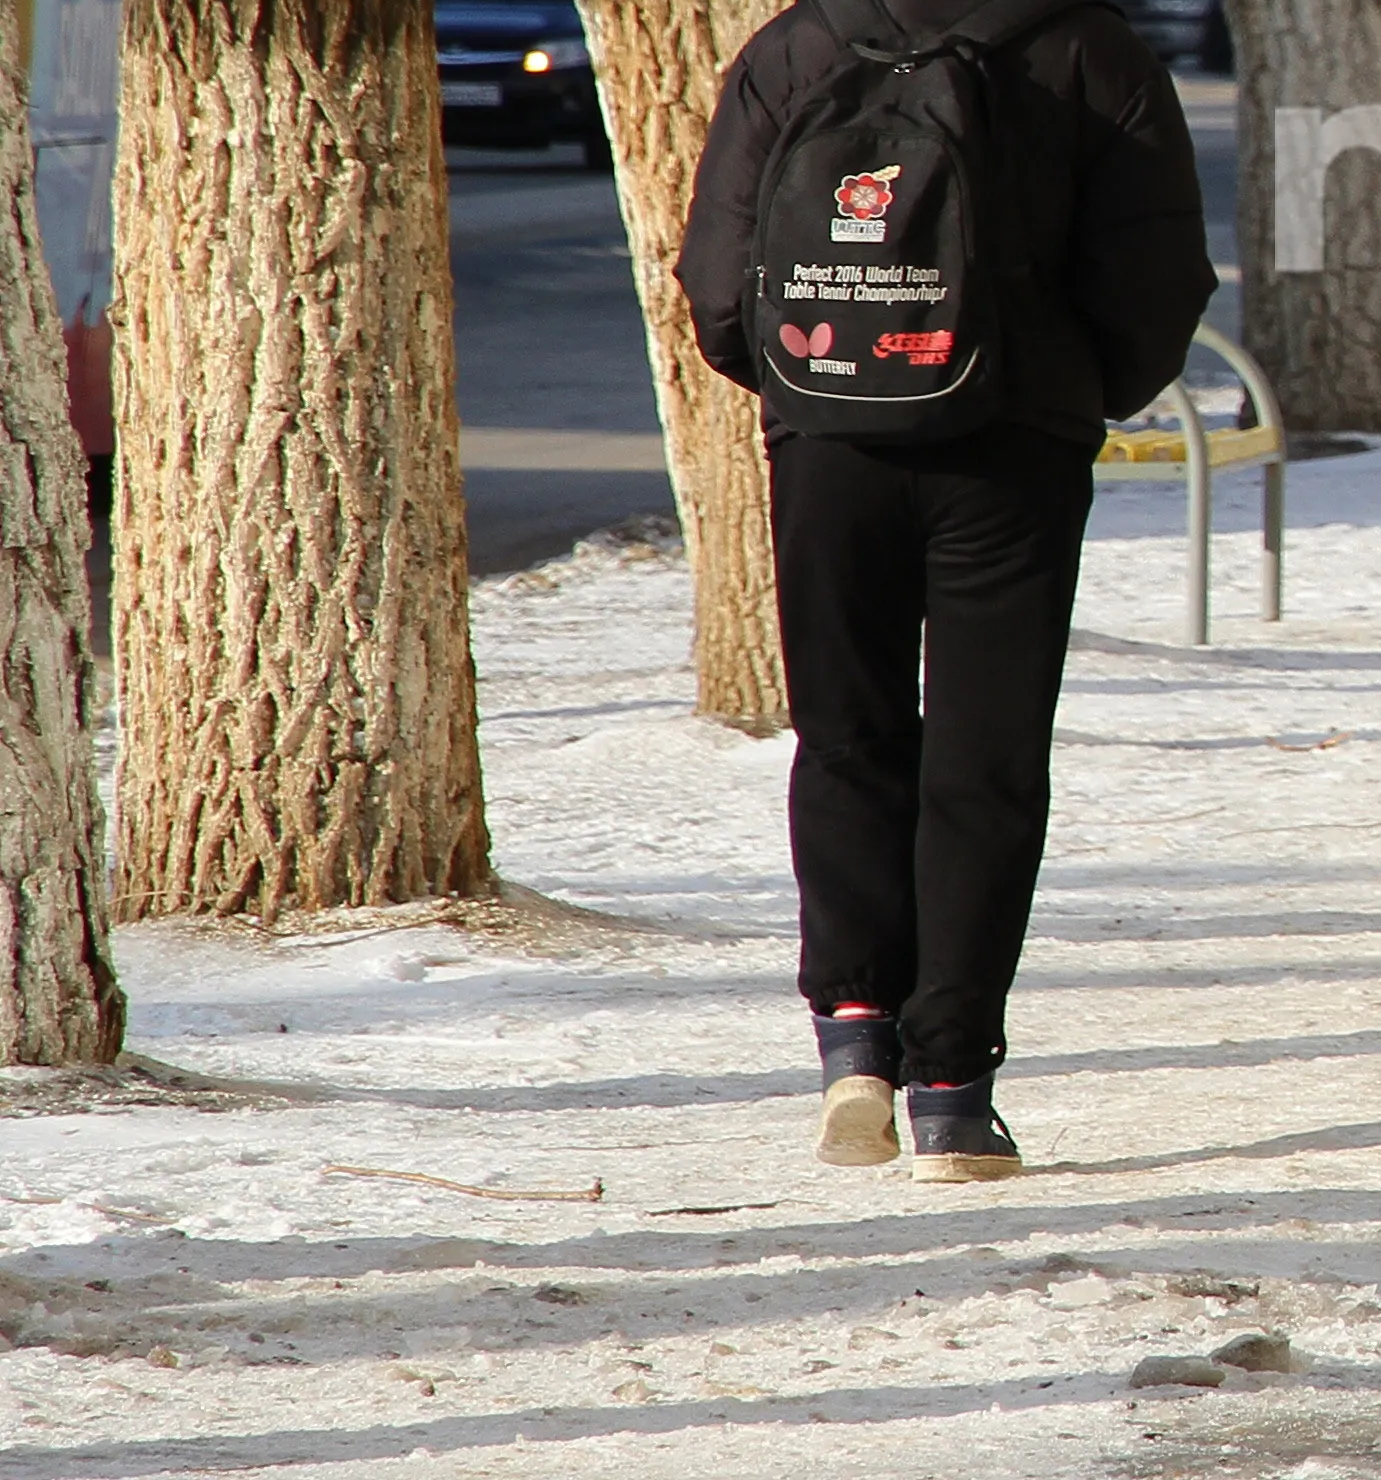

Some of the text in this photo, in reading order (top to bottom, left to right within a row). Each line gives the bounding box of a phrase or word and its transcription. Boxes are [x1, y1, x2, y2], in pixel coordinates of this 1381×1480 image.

[793, 264, 940, 283] Perfect 2016 World Team
[783, 282, 947, 306] Table Tennis Championships
[809, 358, 857, 376] BUTTERFLY
